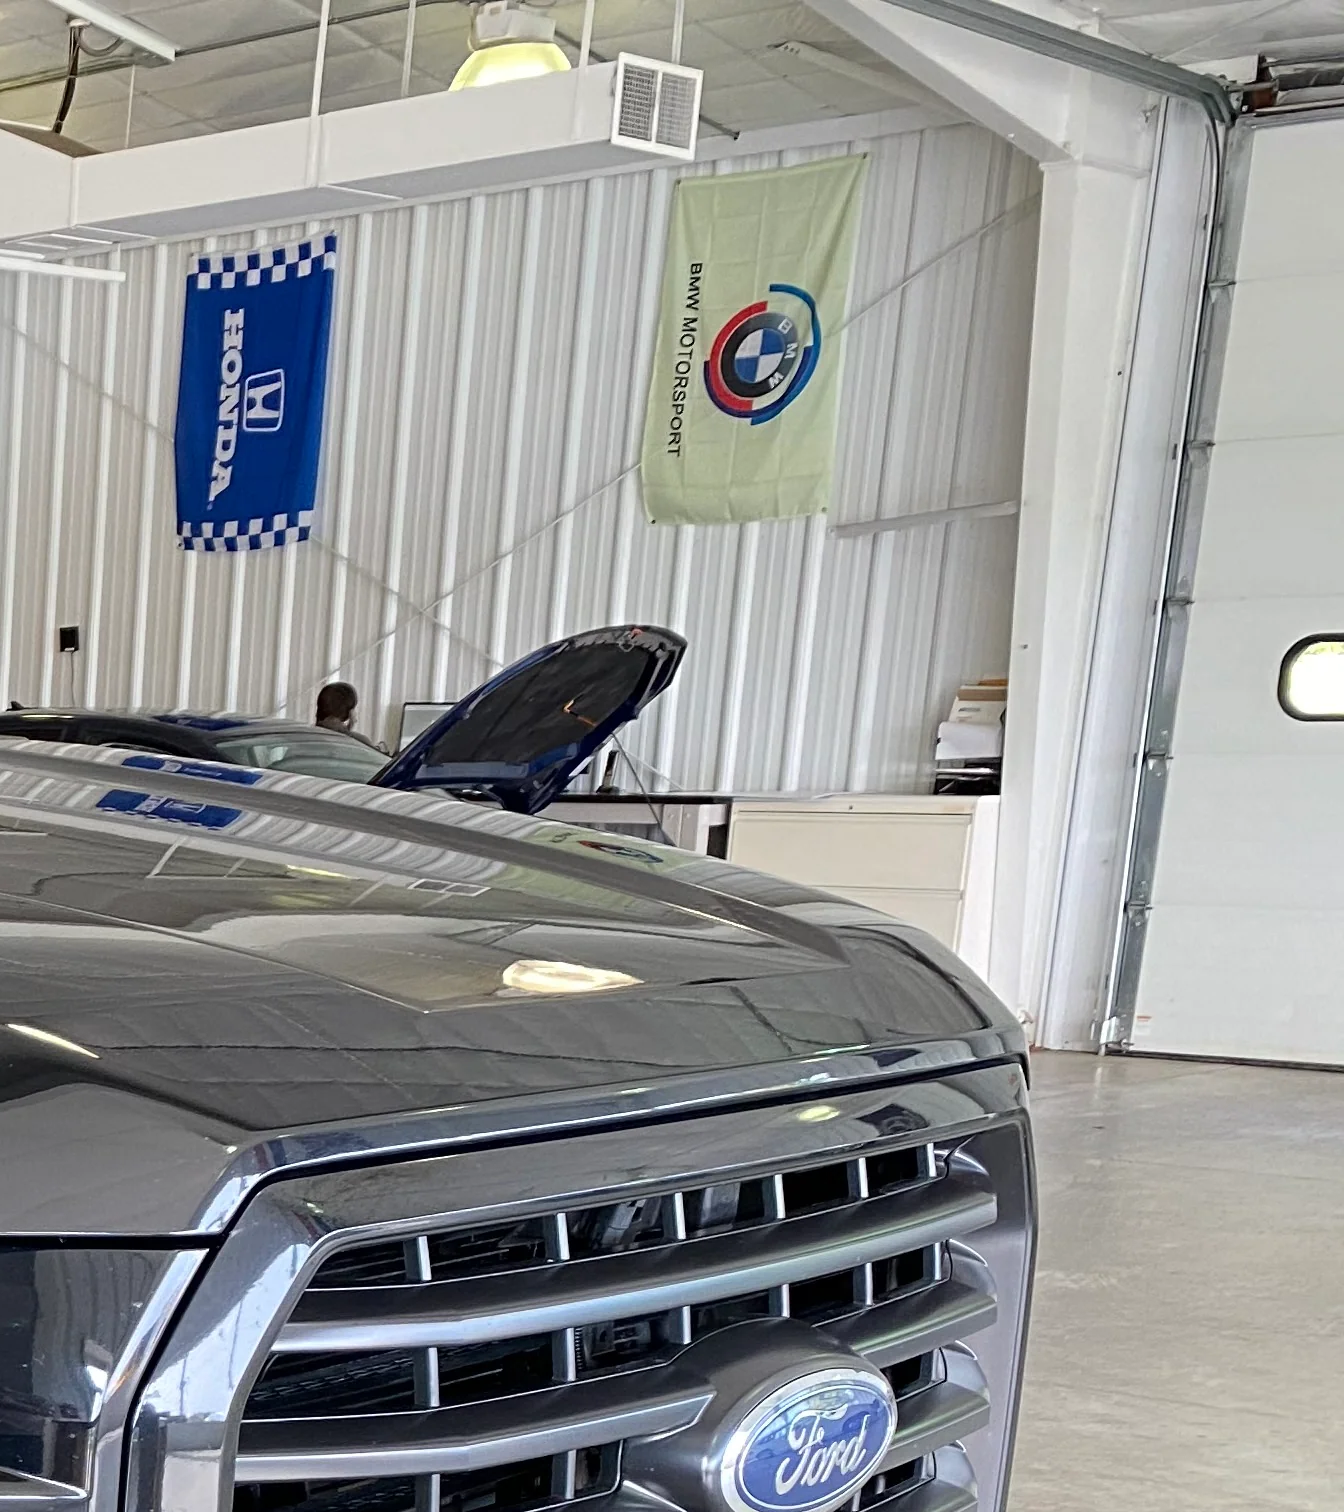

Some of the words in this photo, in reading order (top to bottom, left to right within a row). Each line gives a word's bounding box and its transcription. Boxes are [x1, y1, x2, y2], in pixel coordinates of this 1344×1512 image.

[685, 262, 703, 311] BMW
[209, 308, 245, 502] HONDA
[667, 316, 699, 458] MOTORSPORT
[775, 1403, 871, 1496] Ford
